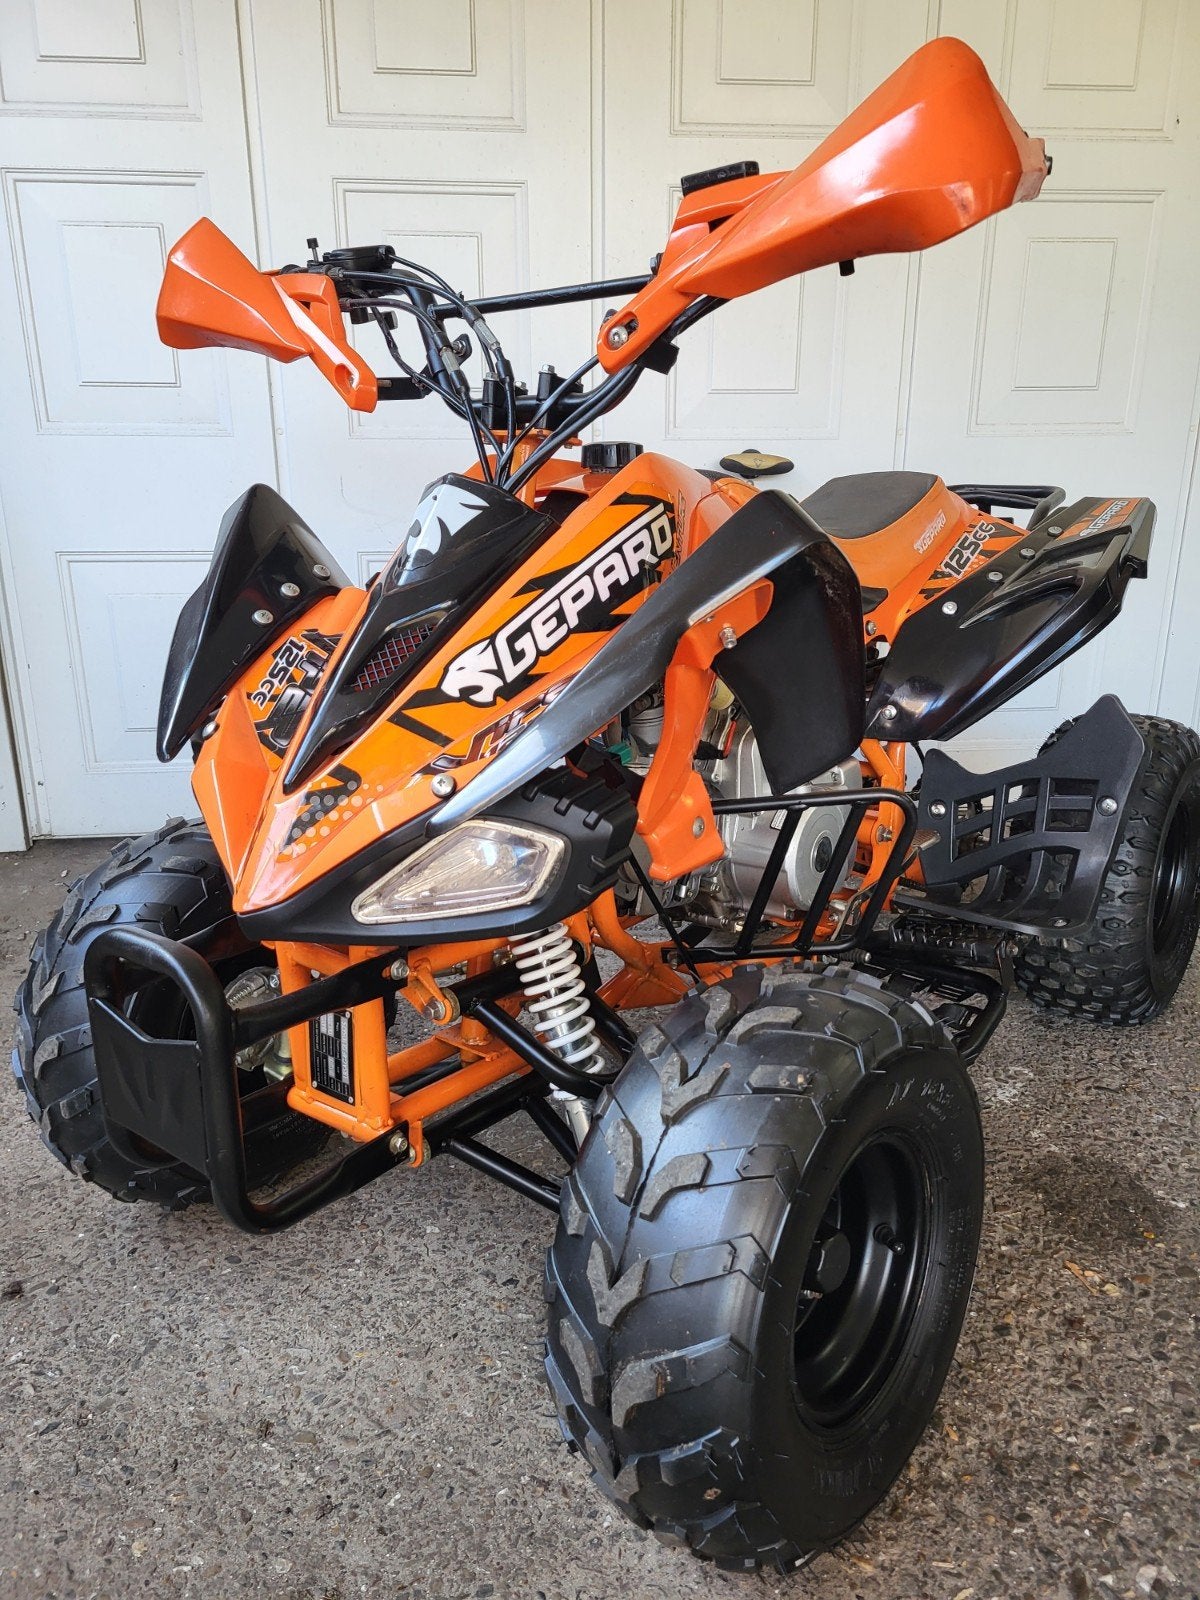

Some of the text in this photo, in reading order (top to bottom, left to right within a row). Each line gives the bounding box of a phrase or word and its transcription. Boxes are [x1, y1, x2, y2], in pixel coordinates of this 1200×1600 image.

[920, 509, 946, 551] GEPARD
[1089, 500, 1130, 529] GEPARD
[495, 503, 673, 683] GEPARD
